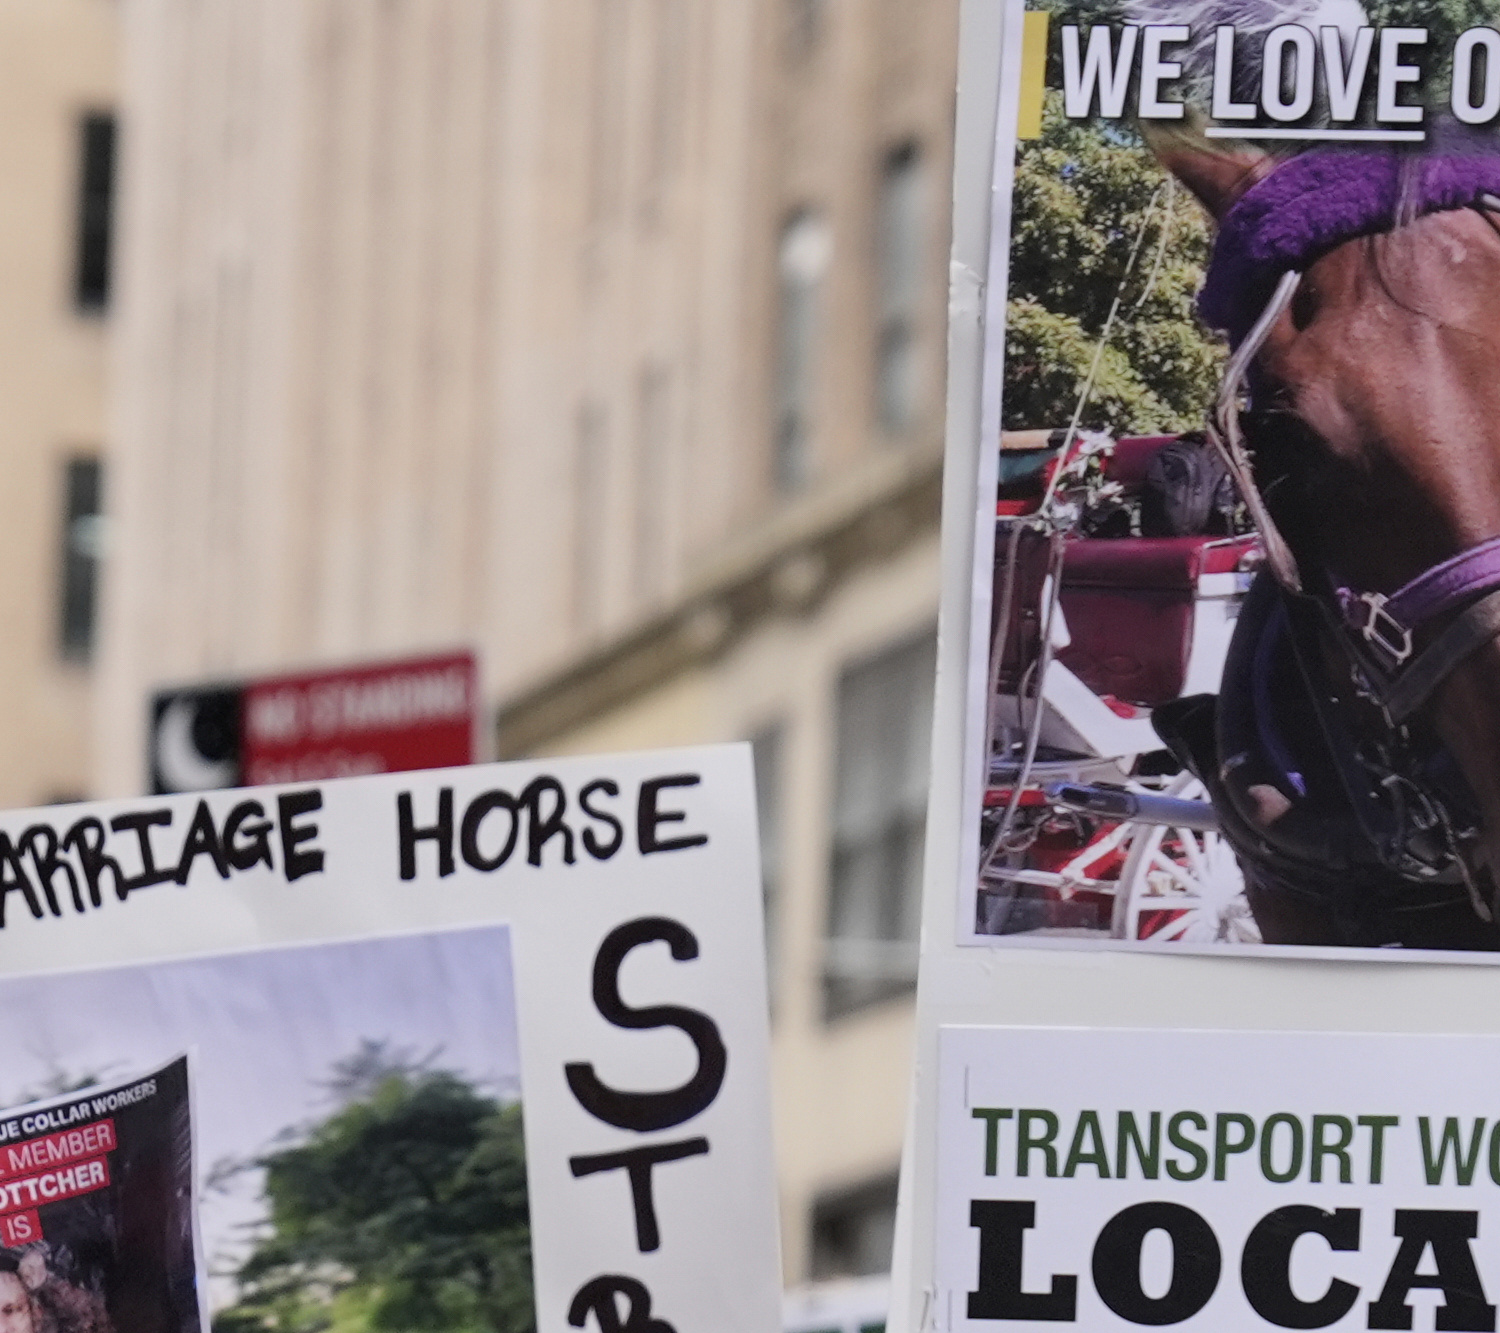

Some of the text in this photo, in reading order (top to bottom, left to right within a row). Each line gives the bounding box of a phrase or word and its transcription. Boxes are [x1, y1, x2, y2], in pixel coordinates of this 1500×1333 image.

[1059, 24, 1188, 122] WE
[1206, 24, 1428, 124] LOVE
[397, 773, 710, 882] HORSE
[21, 1102, 91, 1135] COLLAR
[93, 1079, 157, 1116] WORKERS
[8, 1123, 112, 1170] MEMBER
[971, 1107, 1403, 1187] TRANSPORT
[7, 1215, 32, 1240] IS
